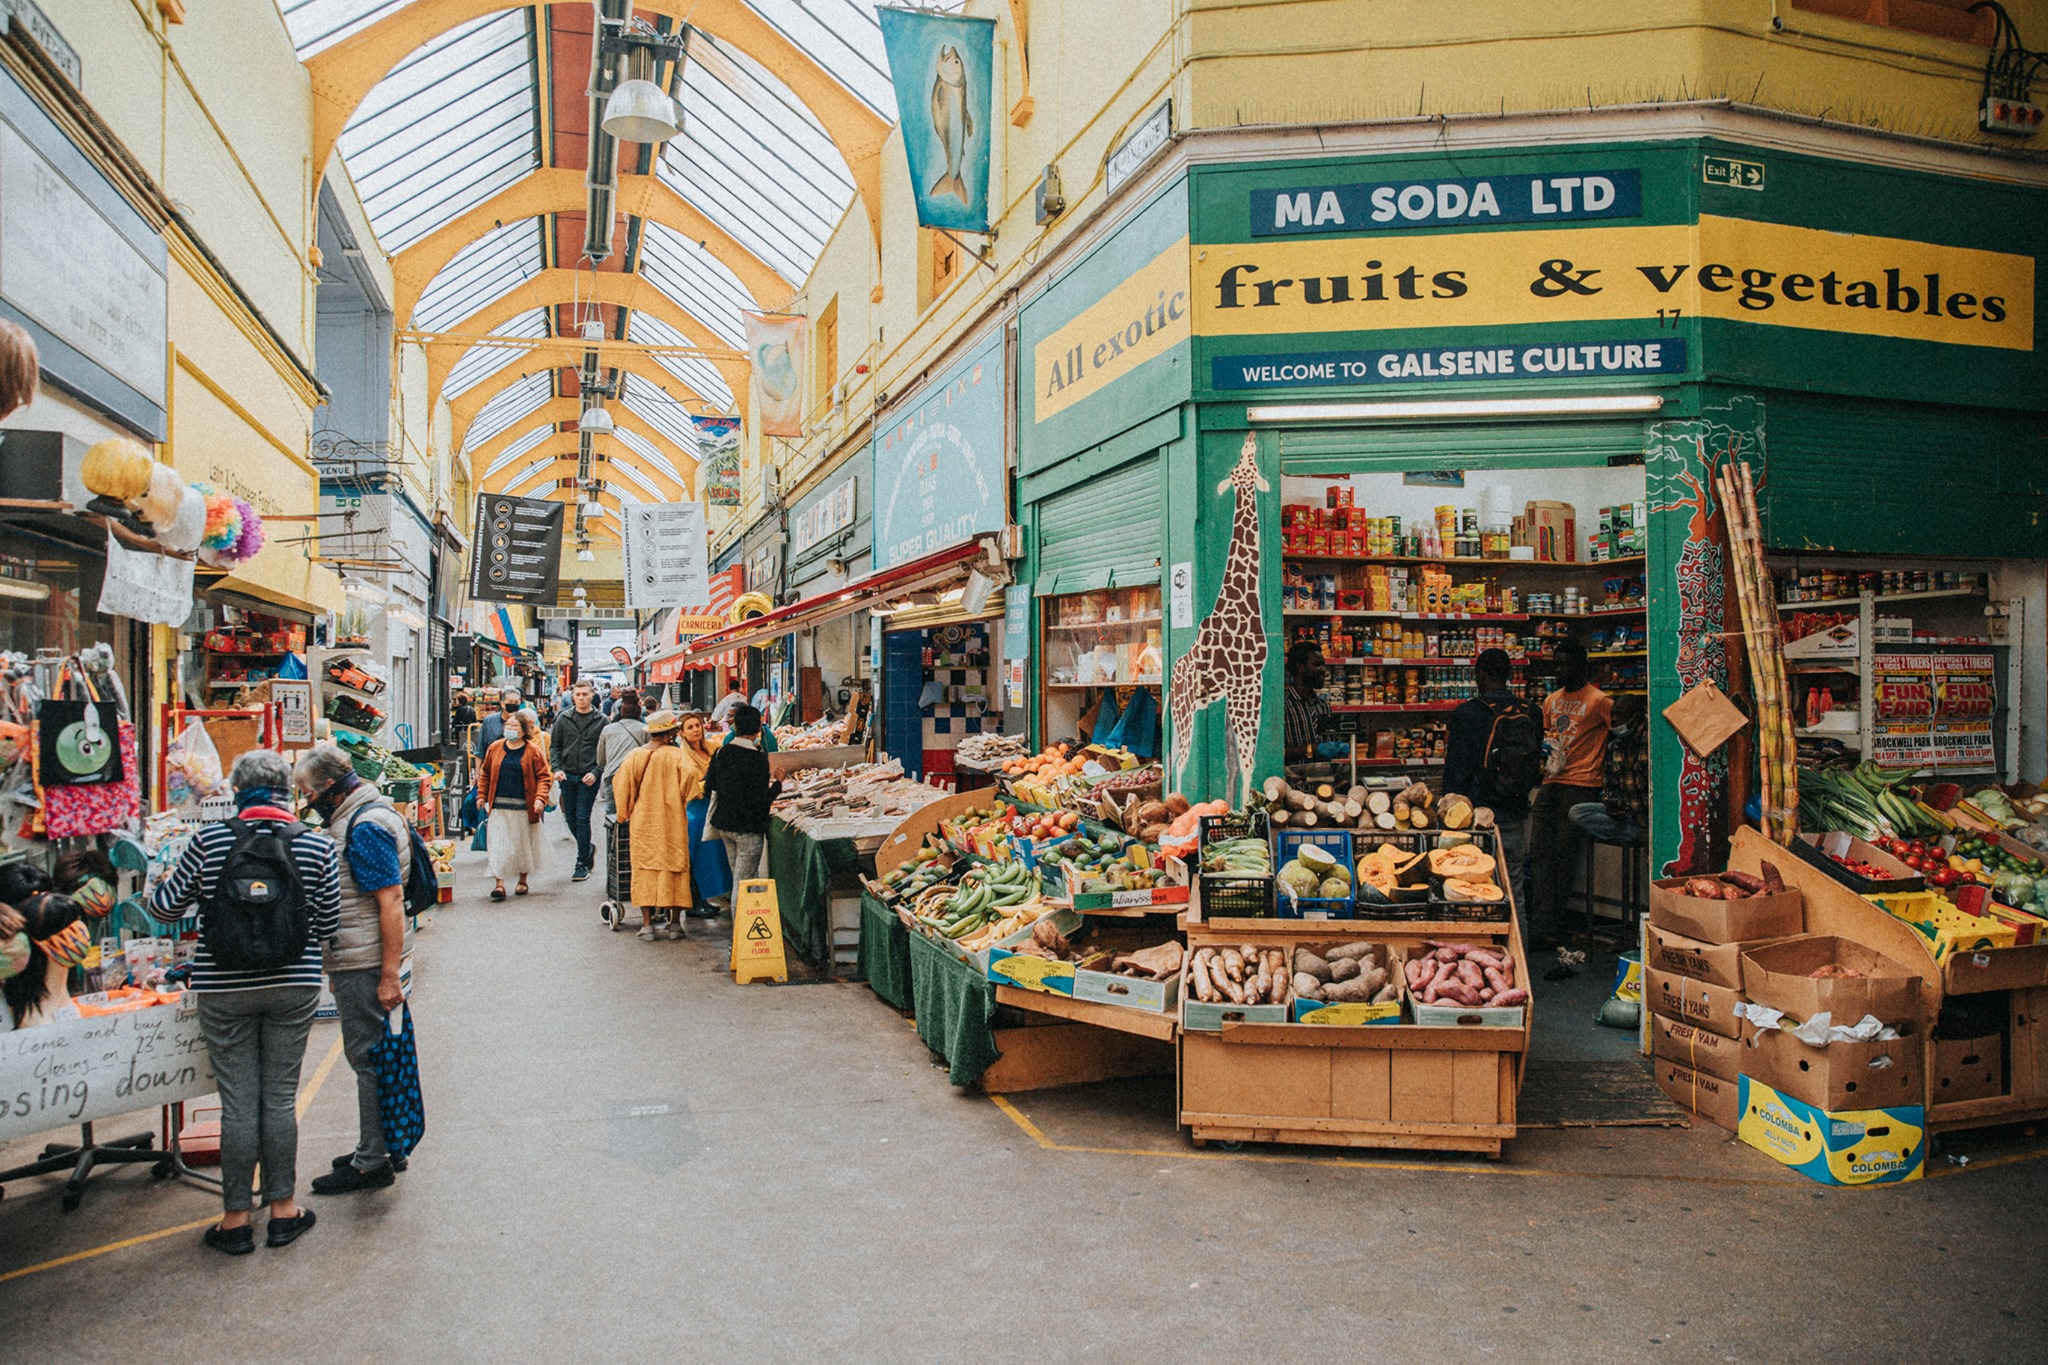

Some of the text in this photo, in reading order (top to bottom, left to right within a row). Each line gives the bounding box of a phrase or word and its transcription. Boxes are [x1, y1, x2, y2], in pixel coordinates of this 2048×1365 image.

[1706, 164, 1726, 179] Exit
[1274, 175, 1616, 229] MA SODA LTD
[1214, 259, 2007, 323] fruits & vegetables
[1656, 308, 1681, 330] 17
[1046, 289, 1185, 399] All exotic
[1242, 344, 1662, 383] WELCOME TO GALSENE CULTURE
[320, 465, 351, 476] VENUE
[889, 509, 979, 565] SUPER QUALITY
[681, 620, 723, 630] CARNICERIA
[1875, 656, 1900, 664] VERYDAY
[1901, 656, 1931, 669] 2 TOKENS
[1964, 656, 1992, 669] 2 TOKENS
[1882, 684, 1926, 699] FUN
[1945, 684, 1988, 699] FUN
[1879, 700, 1931, 715] FAIR
[1943, 700, 1992, 716] FAIR
[1914, 736, 1931, 747] PARK
[1934, 735, 1991, 746] BROCKWELL PARK
[1662, 950, 1687, 966] FRESH
[1687, 956, 1711, 973] YAMS
[1663, 992, 1710, 1019] FRESH YAMS
[18, 1036, 70, 1055] Come
[84, 1019, 119, 1040] and
[133, 1014, 163, 1038] buy
[1698, 1032, 1718, 1048] YAM
[33, 1055, 90, 1079] Closing
[102, 1050, 119, 1062] on
[115, 1055, 197, 1099] down
[1699, 1078, 1719, 1094] YAM
[1759, 1108, 1801, 1136] COLOMBA
[1763, 1129, 1781, 1144] JELLY
[1781, 1136, 1798, 1151] NUTS
[1851, 1159, 1906, 1174] COLOMBA
